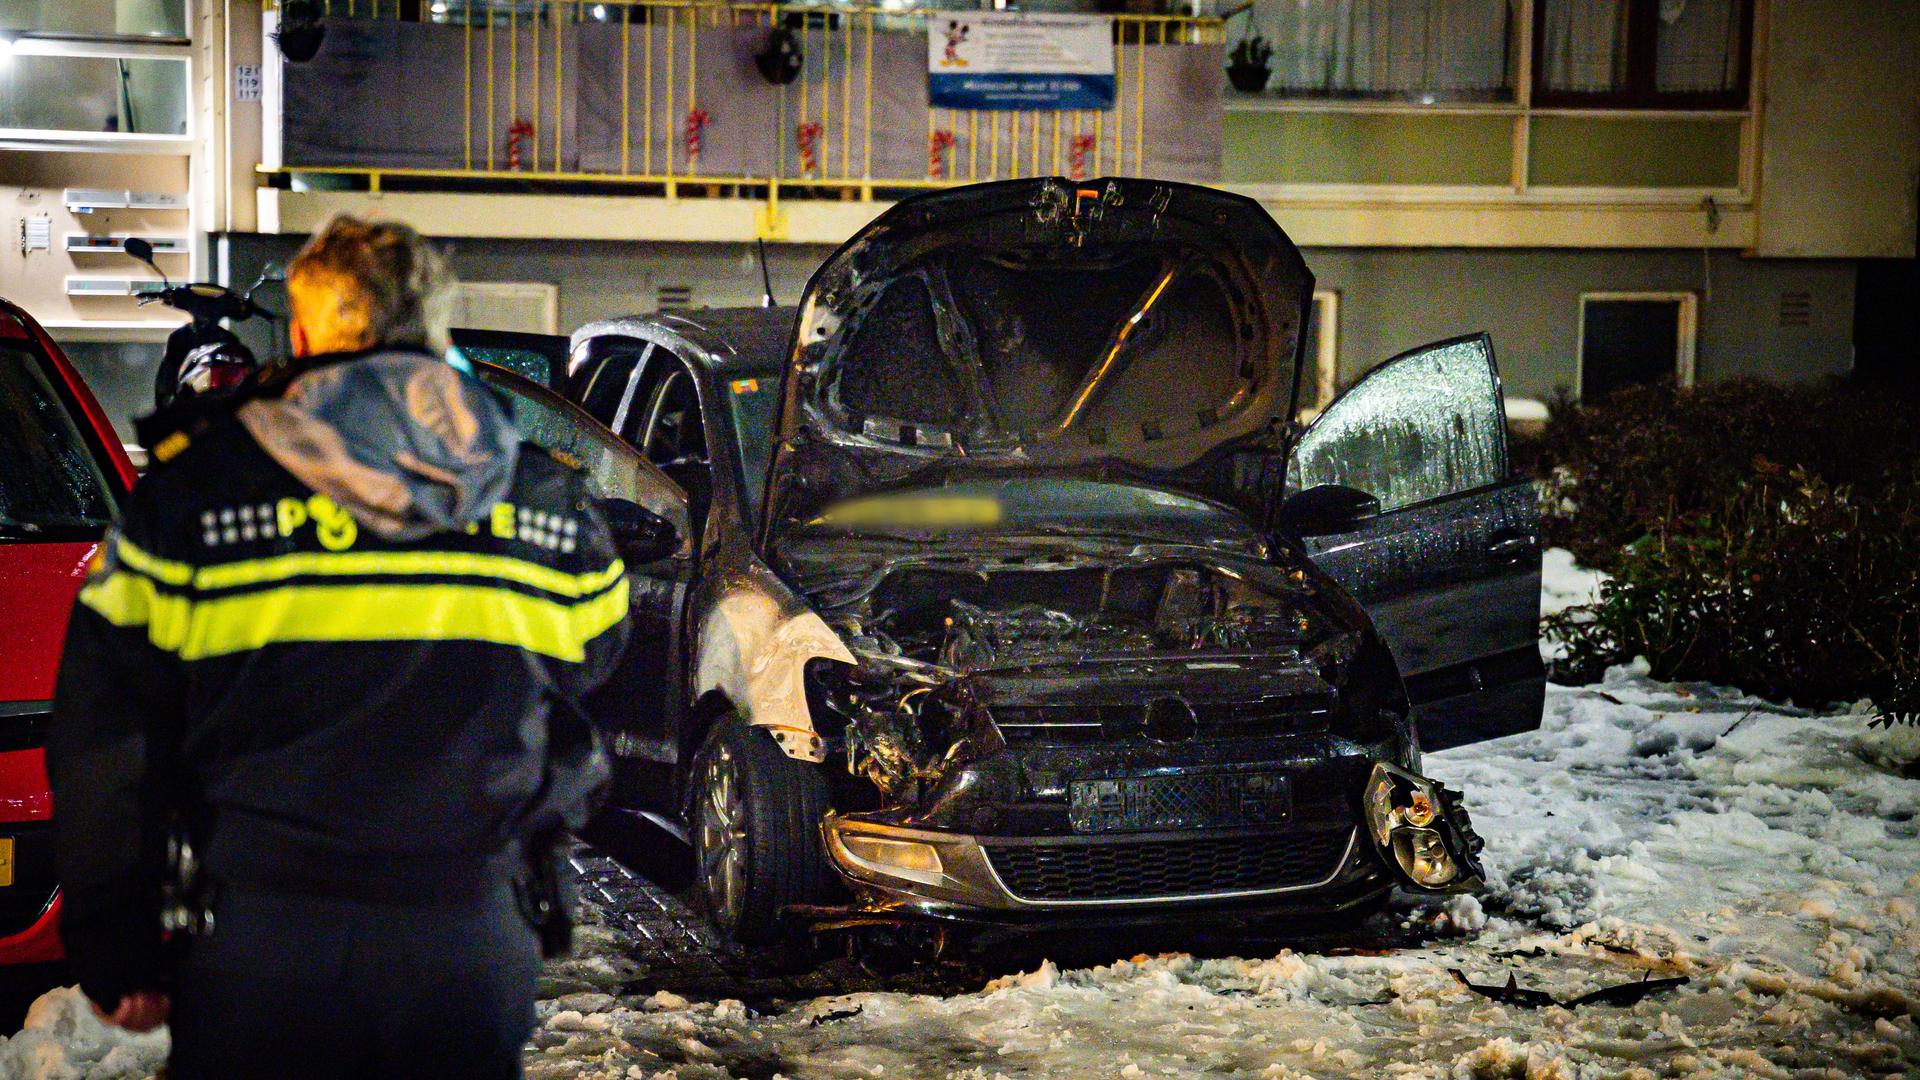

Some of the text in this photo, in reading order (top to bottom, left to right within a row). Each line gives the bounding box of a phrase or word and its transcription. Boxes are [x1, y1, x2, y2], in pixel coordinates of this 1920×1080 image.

[238, 66, 259, 76] 121
[238, 78, 259, 88] 119
[238, 89, 259, 99] 117
